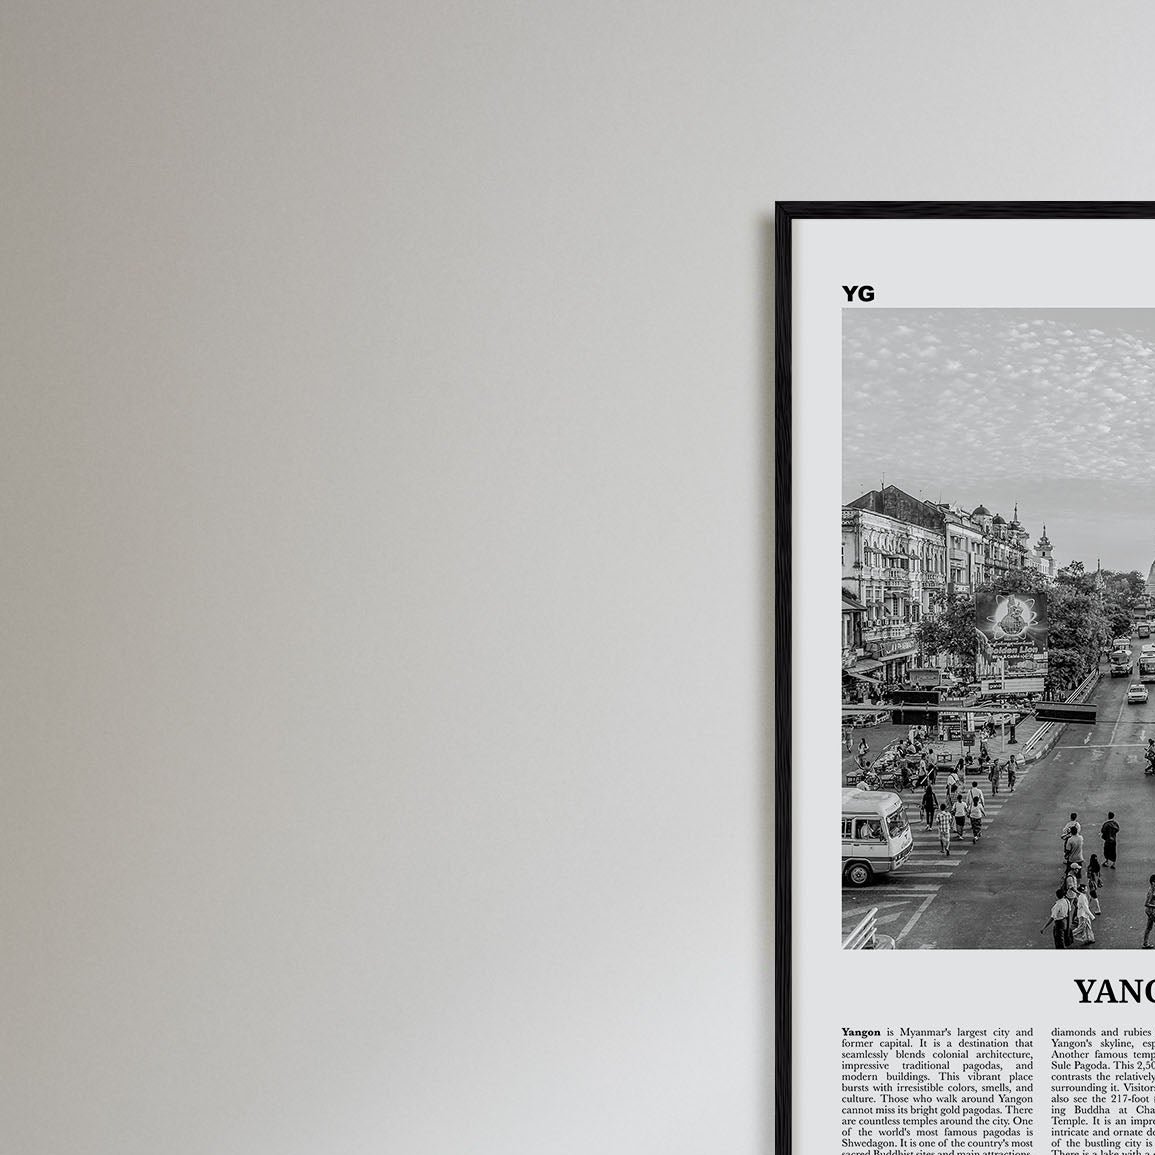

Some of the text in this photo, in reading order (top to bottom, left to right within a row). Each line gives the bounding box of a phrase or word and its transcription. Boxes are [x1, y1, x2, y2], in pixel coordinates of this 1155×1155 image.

[841, 285, 875, 303] YG
[842, 1028, 1033, 1039] Yangon is Myanmar's largest city and
[1051, 1028, 1096, 1036] diamonds
[1101, 1028, 1119, 1036] and
[1124, 1028, 1152, 1036] rubies
[842, 1050, 1033, 1061] seamlessly blends colonial architecture,
[1051, 1050, 1089, 1058] Another
[1095, 1050, 1128, 1058] famous
[842, 1061, 1033, 1072] impressive traditional pagodas, and
[1051, 1061, 1071, 1070] Sule
[1075, 1061, 1110, 1072] Pagoda.
[1113, 1061, 1134, 1070] This
[842, 1072, 1033, 1083] modern buildings. This vibrant place
[1096, 1072, 1111, 1081] the
[842, 1083, 1033, 1093] bursts with irresistible colors, smells, and
[1051, 1083, 1107, 1094] surrounding
[1111, 1083, 1119, 1092] it.
[876, 1105, 895, 1114] miss
[898, 1105, 908, 1114] its
[911, 1105, 938, 1116] bright
[941, 1105, 960, 1116] gold
[963, 1105, 1002, 1116] pagodas.
[1005, 1105, 1033, 1114] There
[1052, 1105, 1066, 1116] ing
[1075, 1105, 1110, 1114] Buddha
[859, 1116, 900, 1125] countless
[903, 1116, 938, 1127] temples
[940, 1116, 973, 1125] around
[976, 1116, 990, 1125] the
[992, 1116, 1010, 1127] city.
[1013, 1116, 1033, 1125] One
[1051, 1116, 1088, 1127] Temple.
[1093, 1116, 1100, 1125] It
[1104, 1116, 1111, 1125] is
